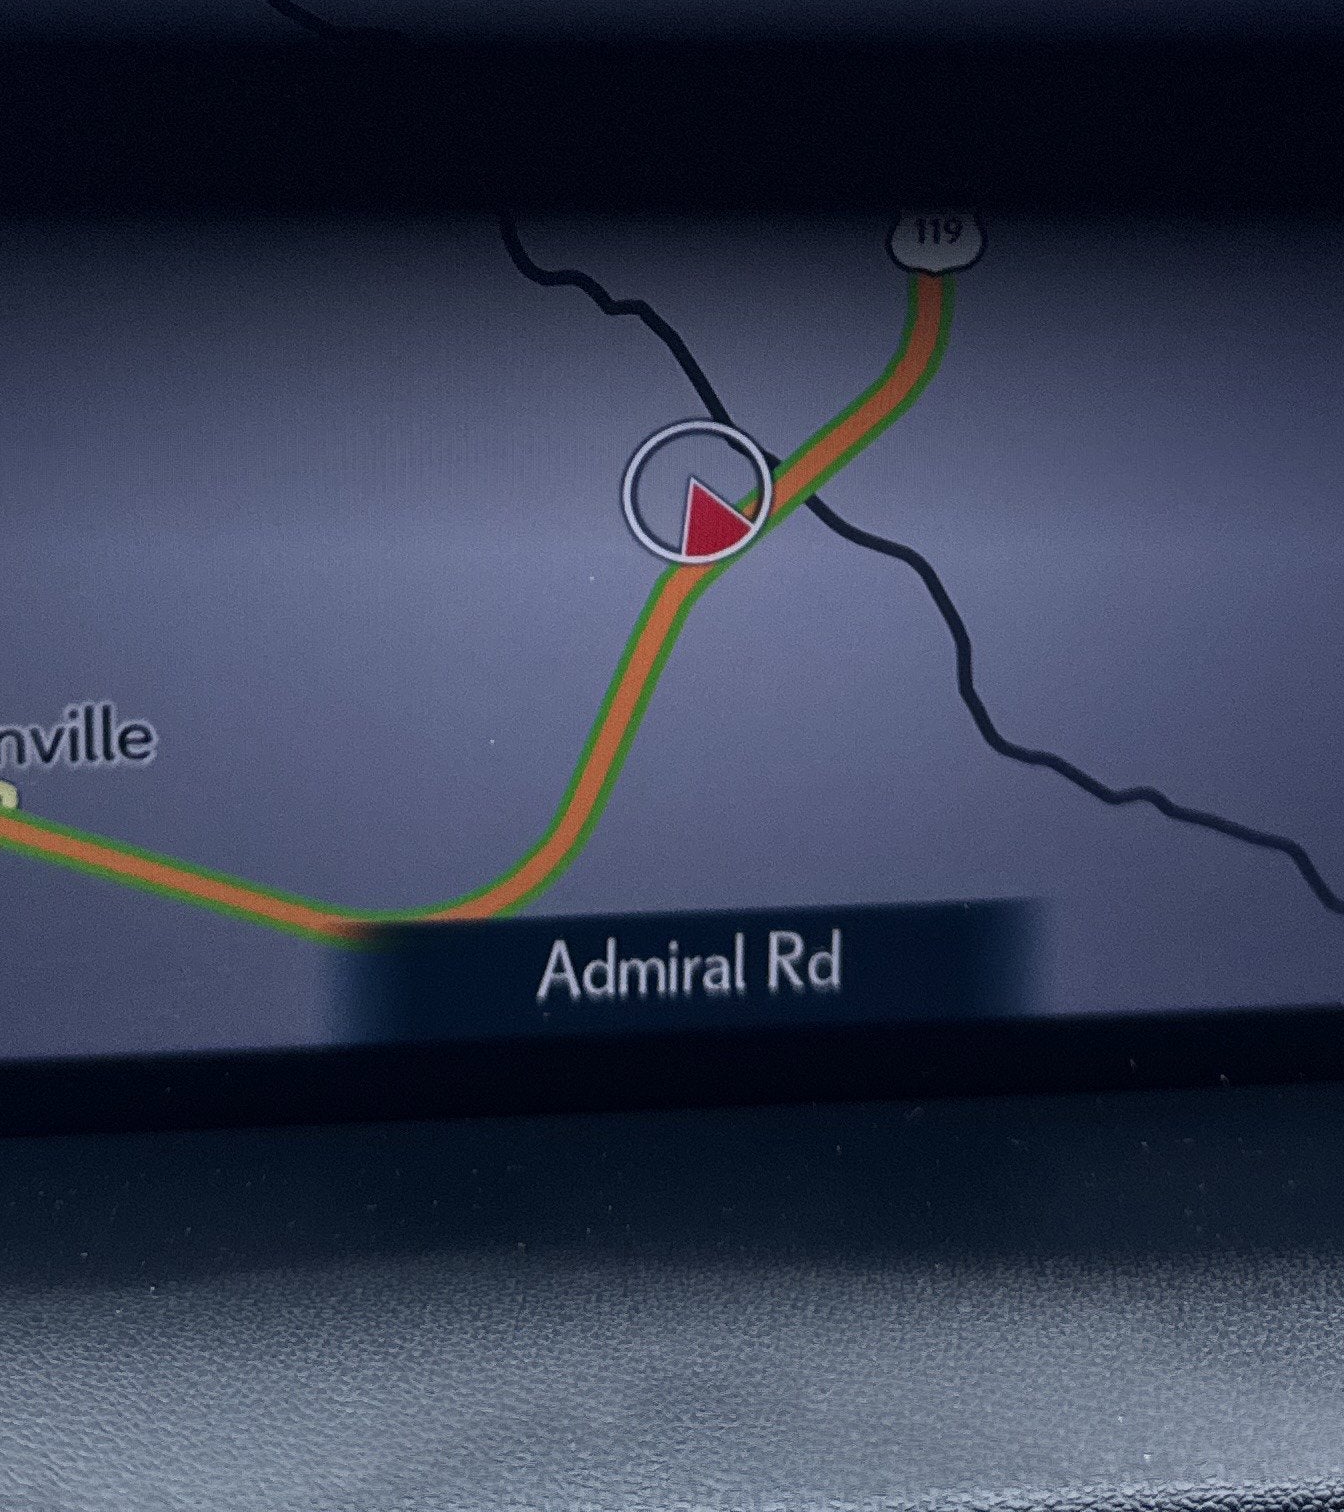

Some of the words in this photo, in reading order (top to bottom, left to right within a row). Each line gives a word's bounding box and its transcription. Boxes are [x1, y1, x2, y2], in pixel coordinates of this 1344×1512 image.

[914, 217, 963, 245] 119
[536, 931, 746, 1000] Admiral
[767, 928, 842, 990] Rd
